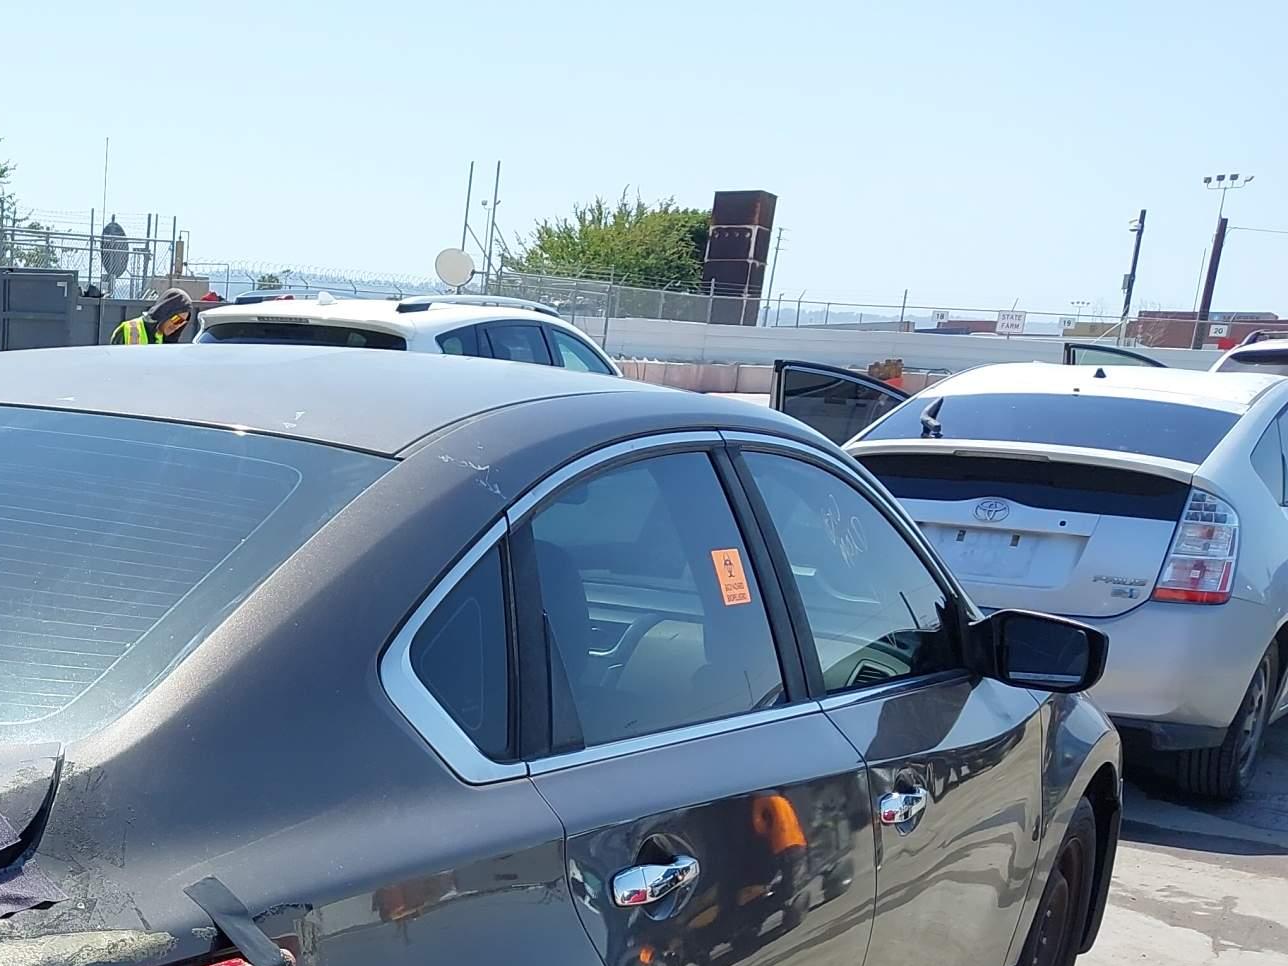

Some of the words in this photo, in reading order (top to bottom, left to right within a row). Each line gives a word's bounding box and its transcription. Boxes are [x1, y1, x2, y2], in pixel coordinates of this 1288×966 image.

[1001, 313, 1022, 321] STATE
[1000, 322, 1020, 330] FARM
[1213, 327, 1224, 335] 20
